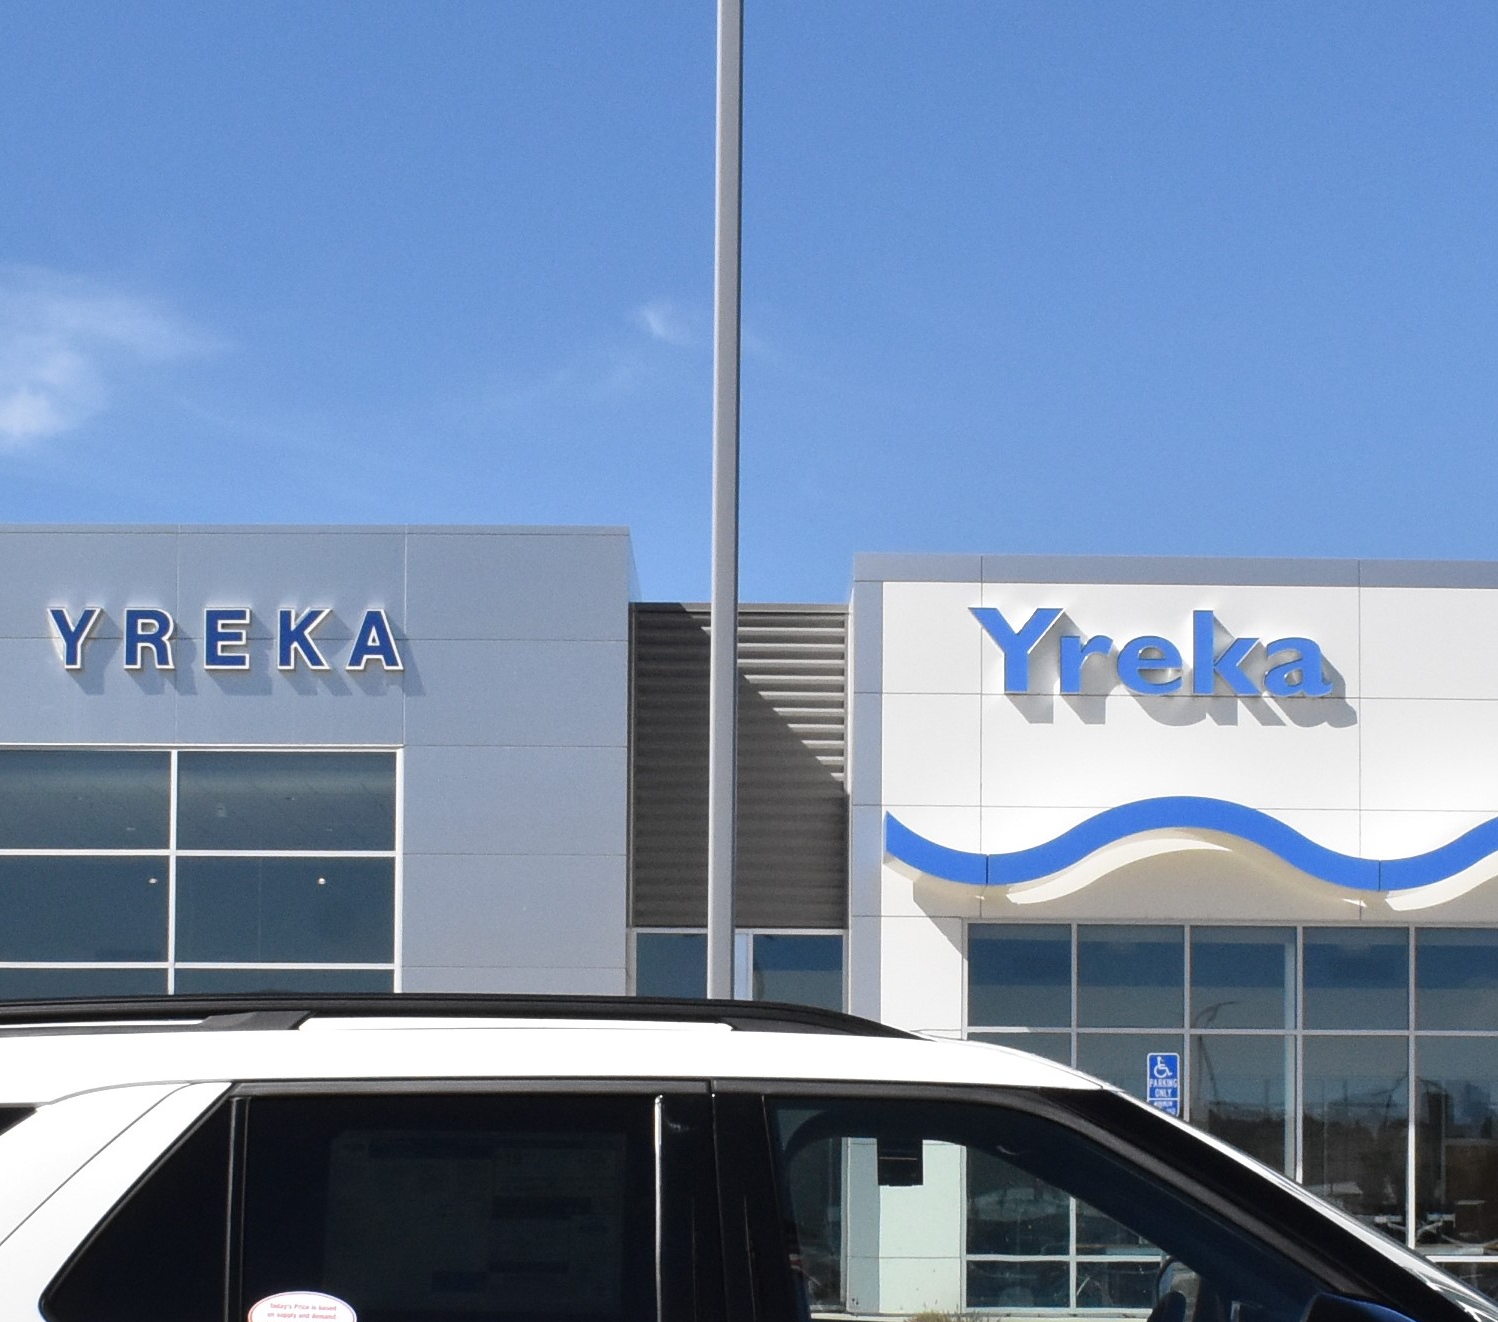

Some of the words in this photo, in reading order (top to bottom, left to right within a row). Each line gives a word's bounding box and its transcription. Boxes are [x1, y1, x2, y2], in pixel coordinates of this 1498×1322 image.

[47, 607, 404, 670] YREKA
[968, 606, 1334, 698] Yreka
[1149, 1079, 1178, 1088] PARKING
[1154, 1088, 1172, 1098] ONLY
[270, 1303, 292, 1311] Today's
